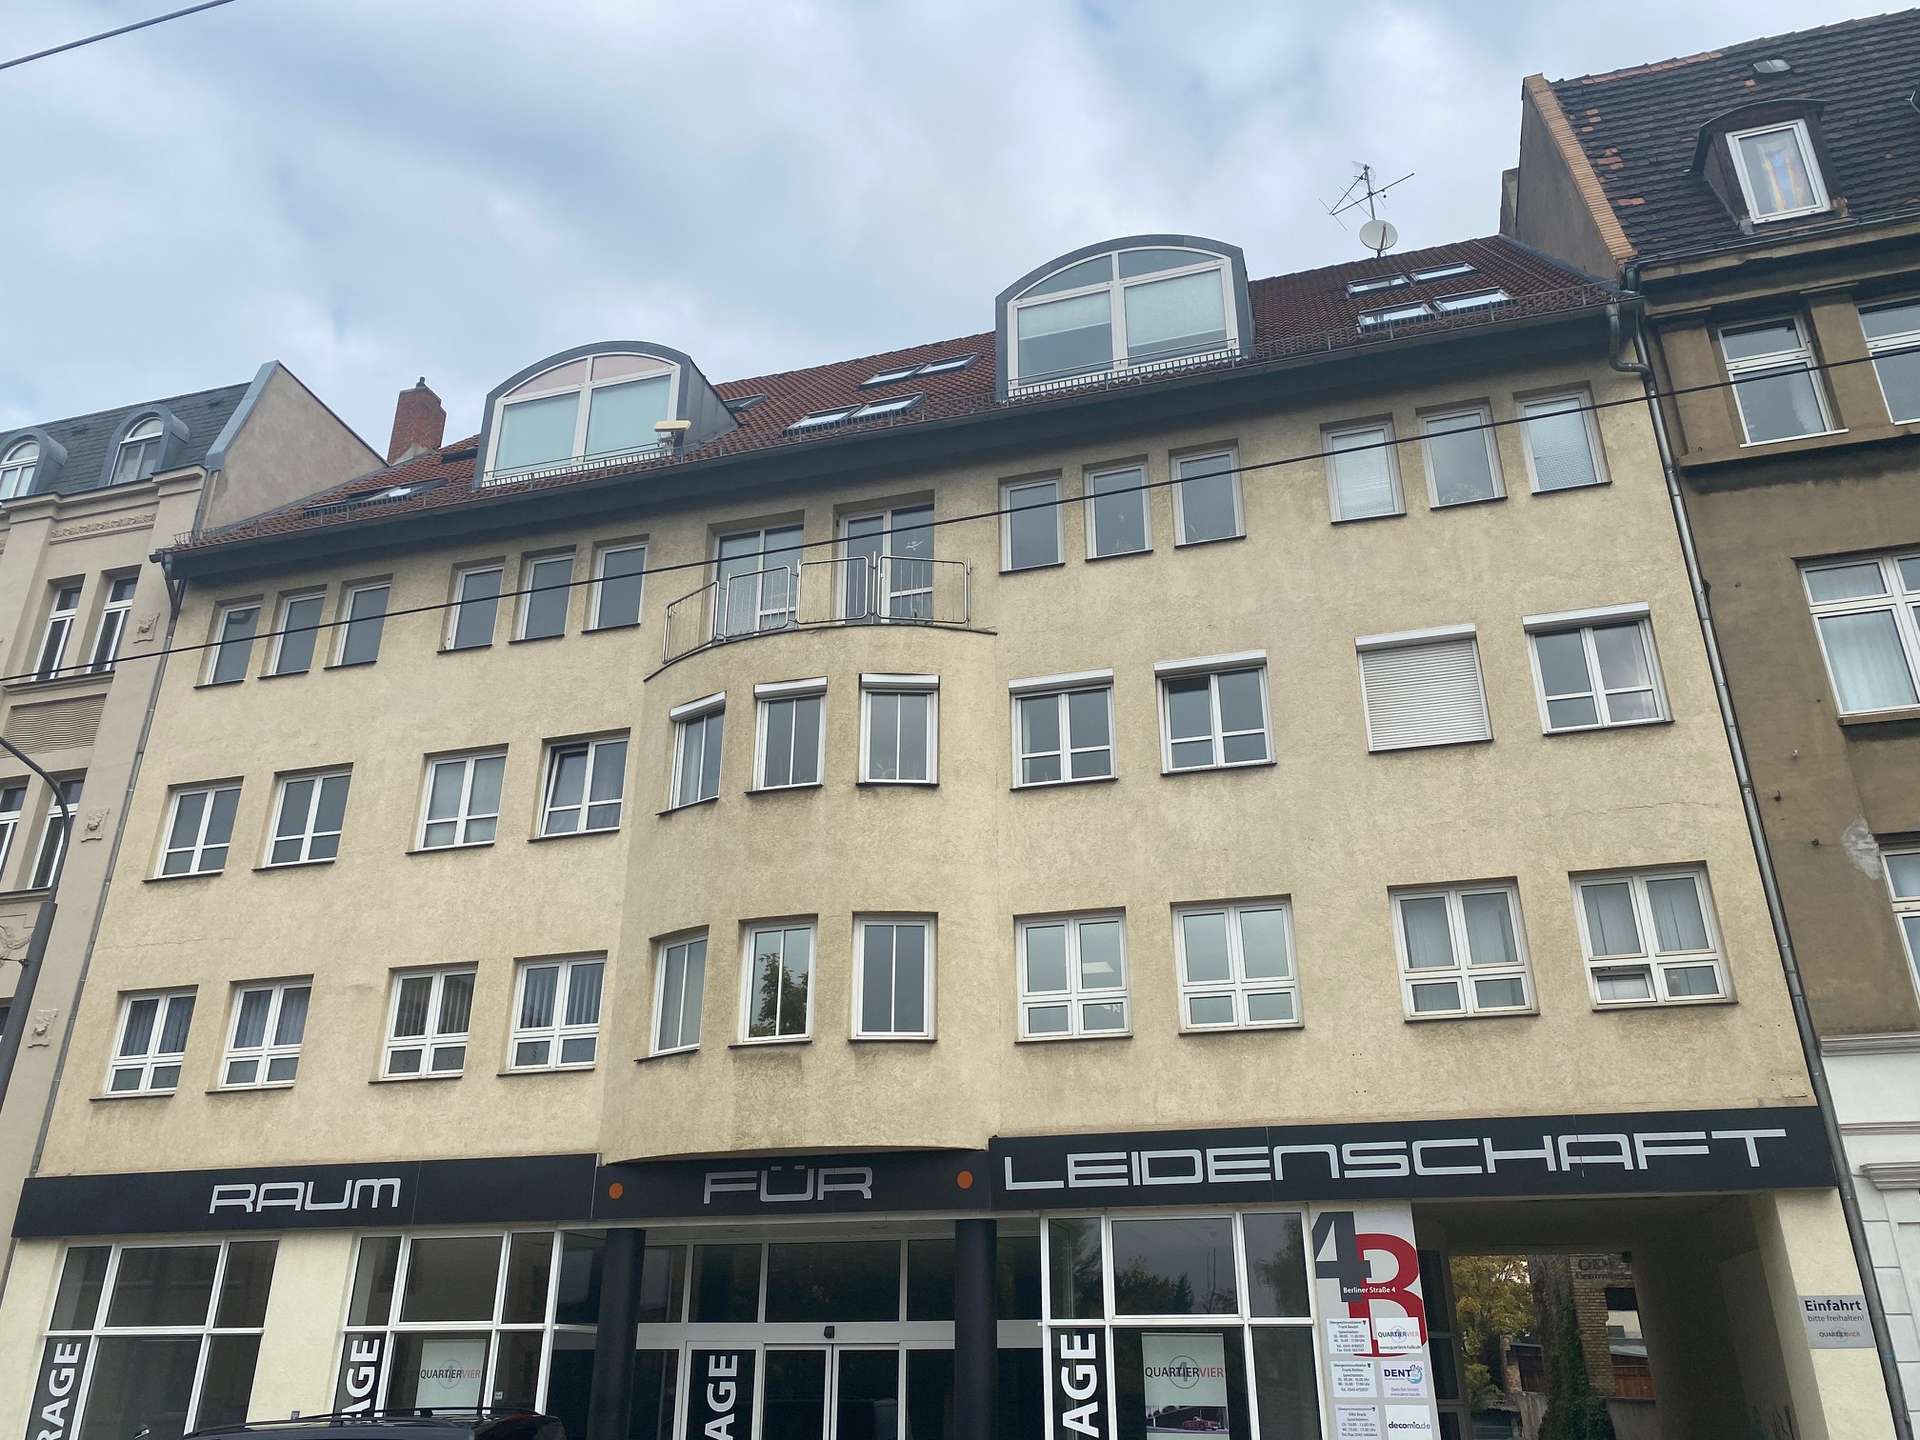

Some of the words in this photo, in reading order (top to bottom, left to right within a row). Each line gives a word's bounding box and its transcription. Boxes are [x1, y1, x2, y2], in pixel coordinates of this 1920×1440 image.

[209, 1177, 401, 1214] RAUM
[703, 1165, 873, 1204] FÜR
[1003, 1128, 1787, 1192] LEIDENSCHAFT
[1343, 1286, 1368, 1294] Berliner
[1369, 1286, 1391, 1294] Straße
[1804, 1299, 1863, 1312] Einfahrt
[1807, 1314, 1826, 1322] bitte
[1144, 1366, 1224, 1378] QUARTIERVIER
